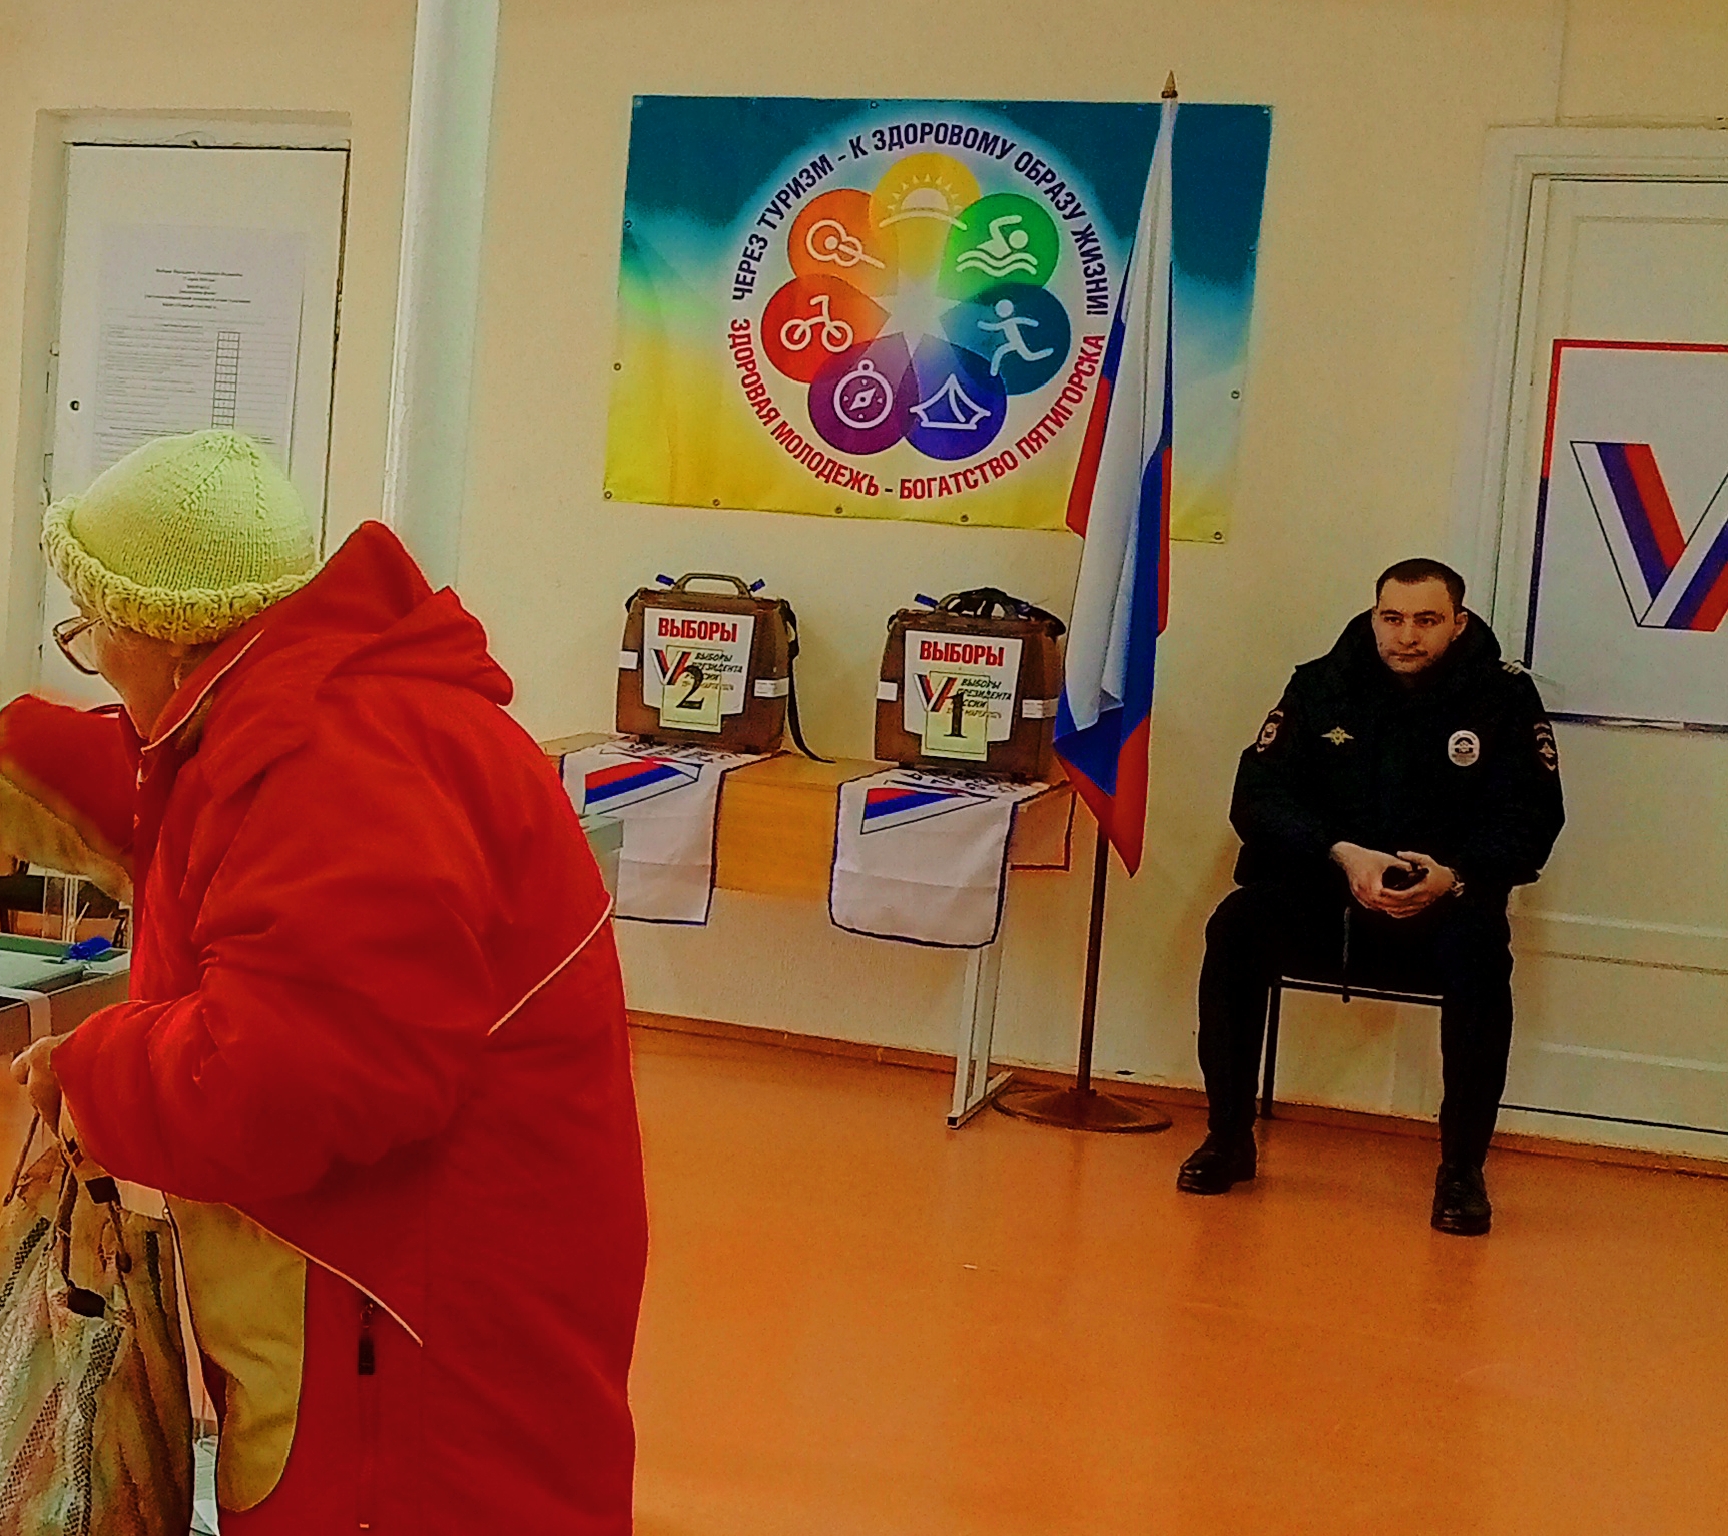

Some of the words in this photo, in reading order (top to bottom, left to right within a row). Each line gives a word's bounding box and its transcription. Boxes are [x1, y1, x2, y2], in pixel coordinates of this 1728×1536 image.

[732, 233, 768, 301] ЧЕРЕЗ
[756, 154, 835, 230] ТУРИЗМ
[848, 135, 868, 159] К
[872, 122, 1017, 160] ЗДОРОВОМУ
[1014, 151, 1087, 221] ОБРАЗУ
[1070, 222, 1109, 316] ЖИЗНИ!
[728, 319, 781, 427] ЗДОРОВАЯ
[770, 420, 880, 497] МОЛОДЕЖЬ
[899, 449, 1019, 500] БОГАТСТВО
[1014, 334, 1106, 460] ПЯТИГОРСКА
[657, 617, 738, 642] ВЫБОРЫ
[920, 640, 1004, 666] ВЫБОРЫ
[676, 664, 705, 710] 2
[943, 691, 967, 739] 1
